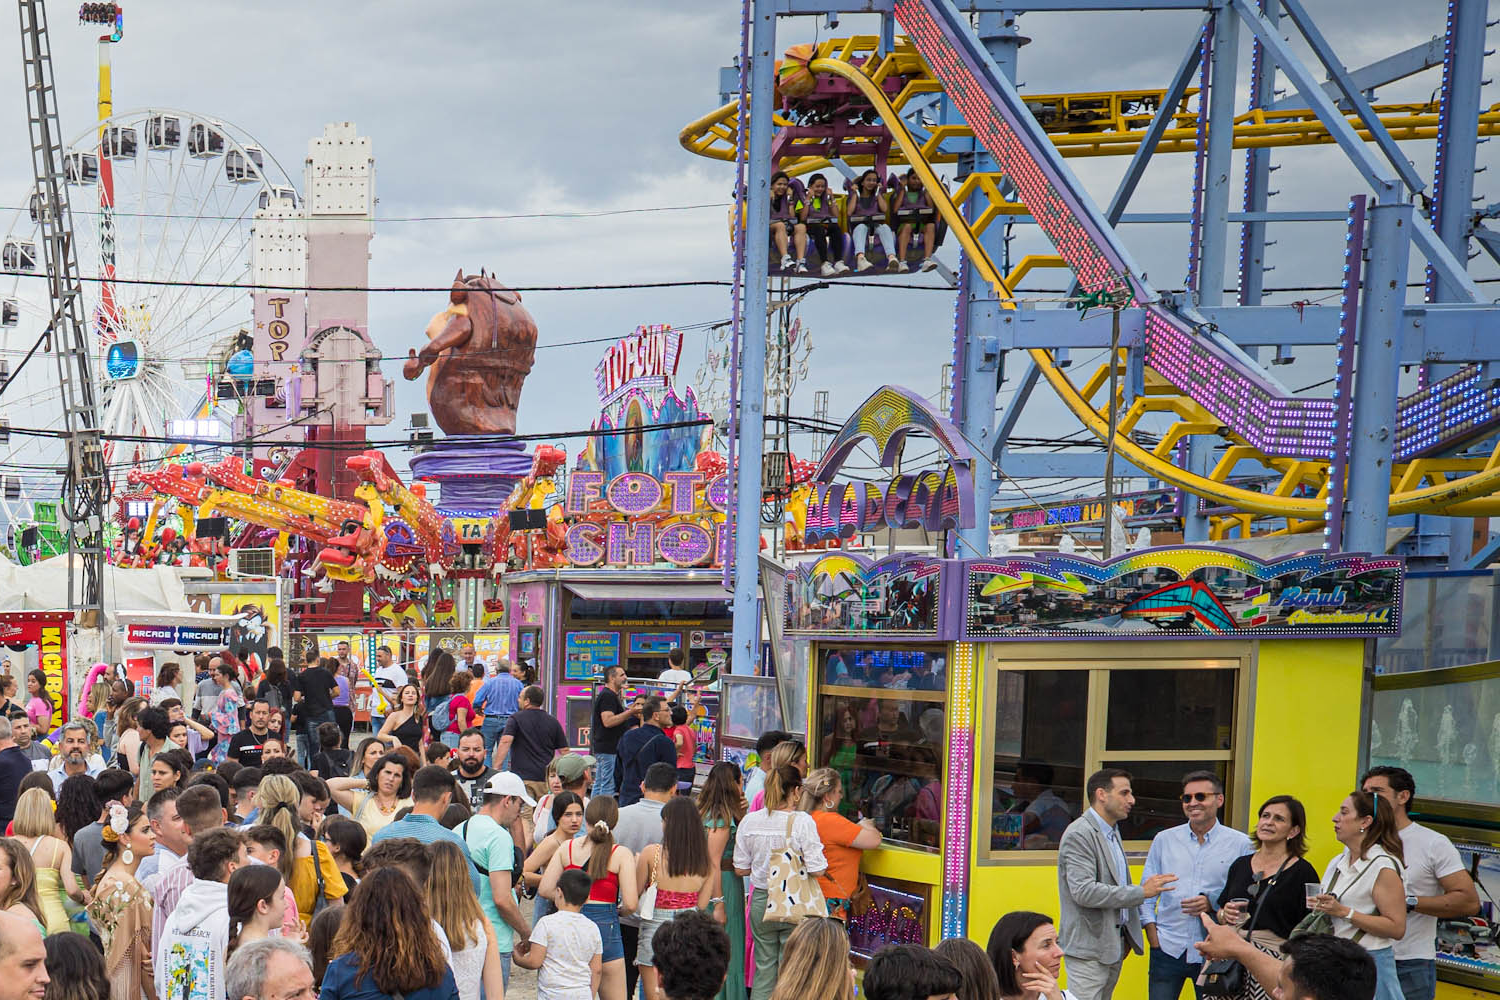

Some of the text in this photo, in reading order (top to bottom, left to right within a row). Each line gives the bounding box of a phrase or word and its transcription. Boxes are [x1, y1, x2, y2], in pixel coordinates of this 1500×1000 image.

[267, 297, 290, 361] TOP
[1275, 584, 1347, 607] Bañuls
[132, 629, 171, 639] ARCADE
[181, 631, 219, 640] ARCADE
